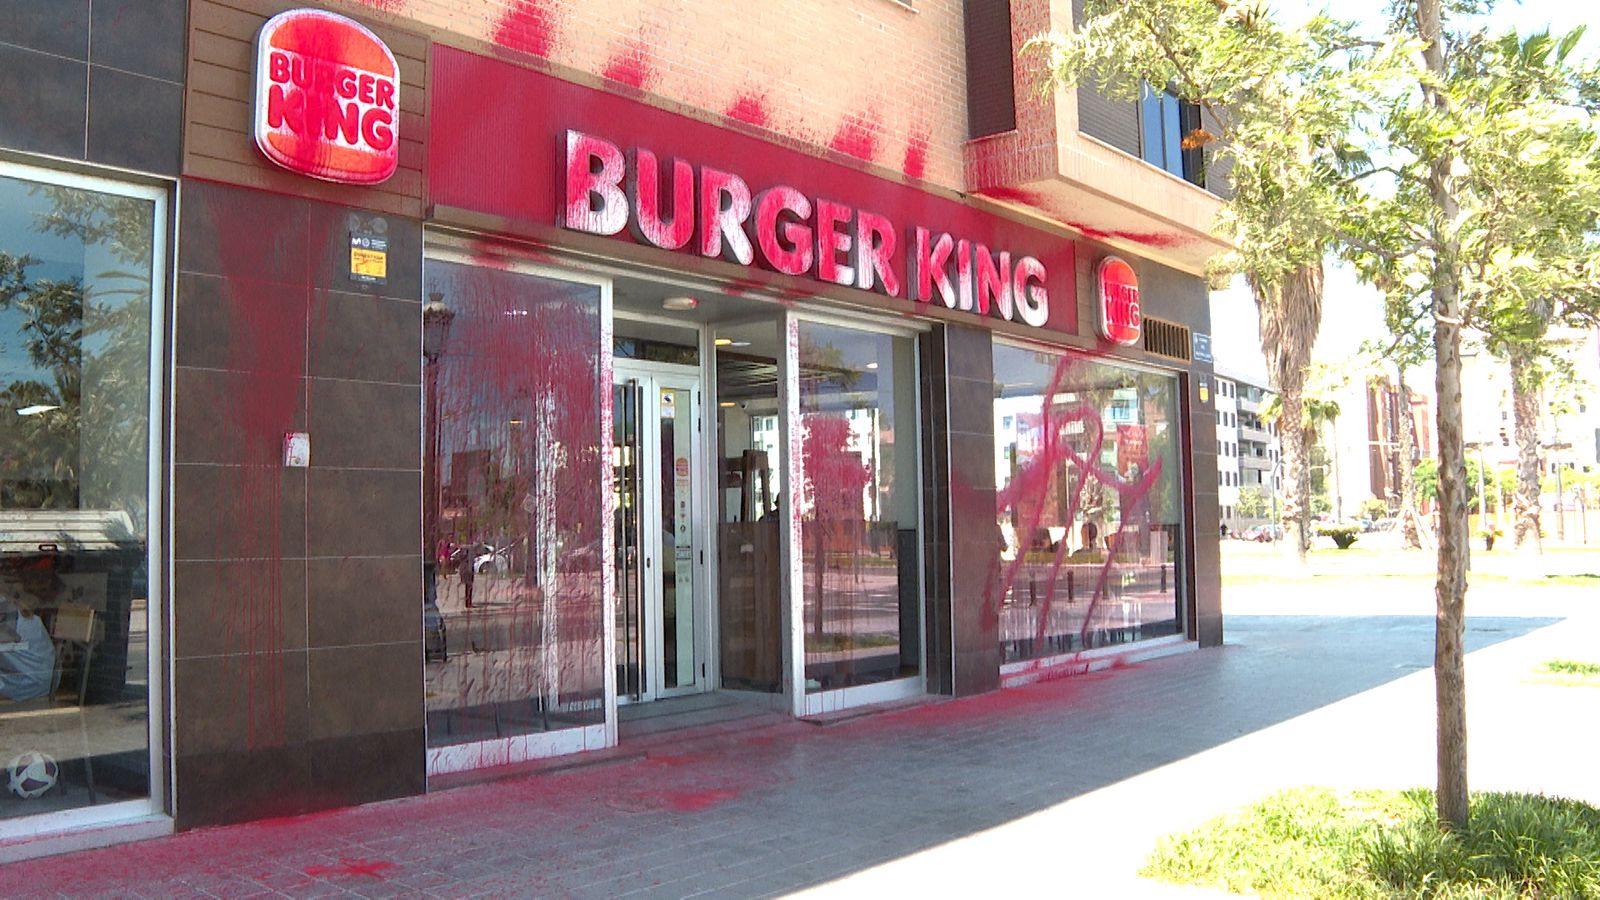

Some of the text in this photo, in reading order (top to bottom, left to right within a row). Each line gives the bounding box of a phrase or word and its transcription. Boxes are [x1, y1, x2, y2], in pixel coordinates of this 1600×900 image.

[267, 84, 394, 151] KING
[565, 127, 1049, 327] BURGER KING
[1104, 282, 1140, 305] GER
